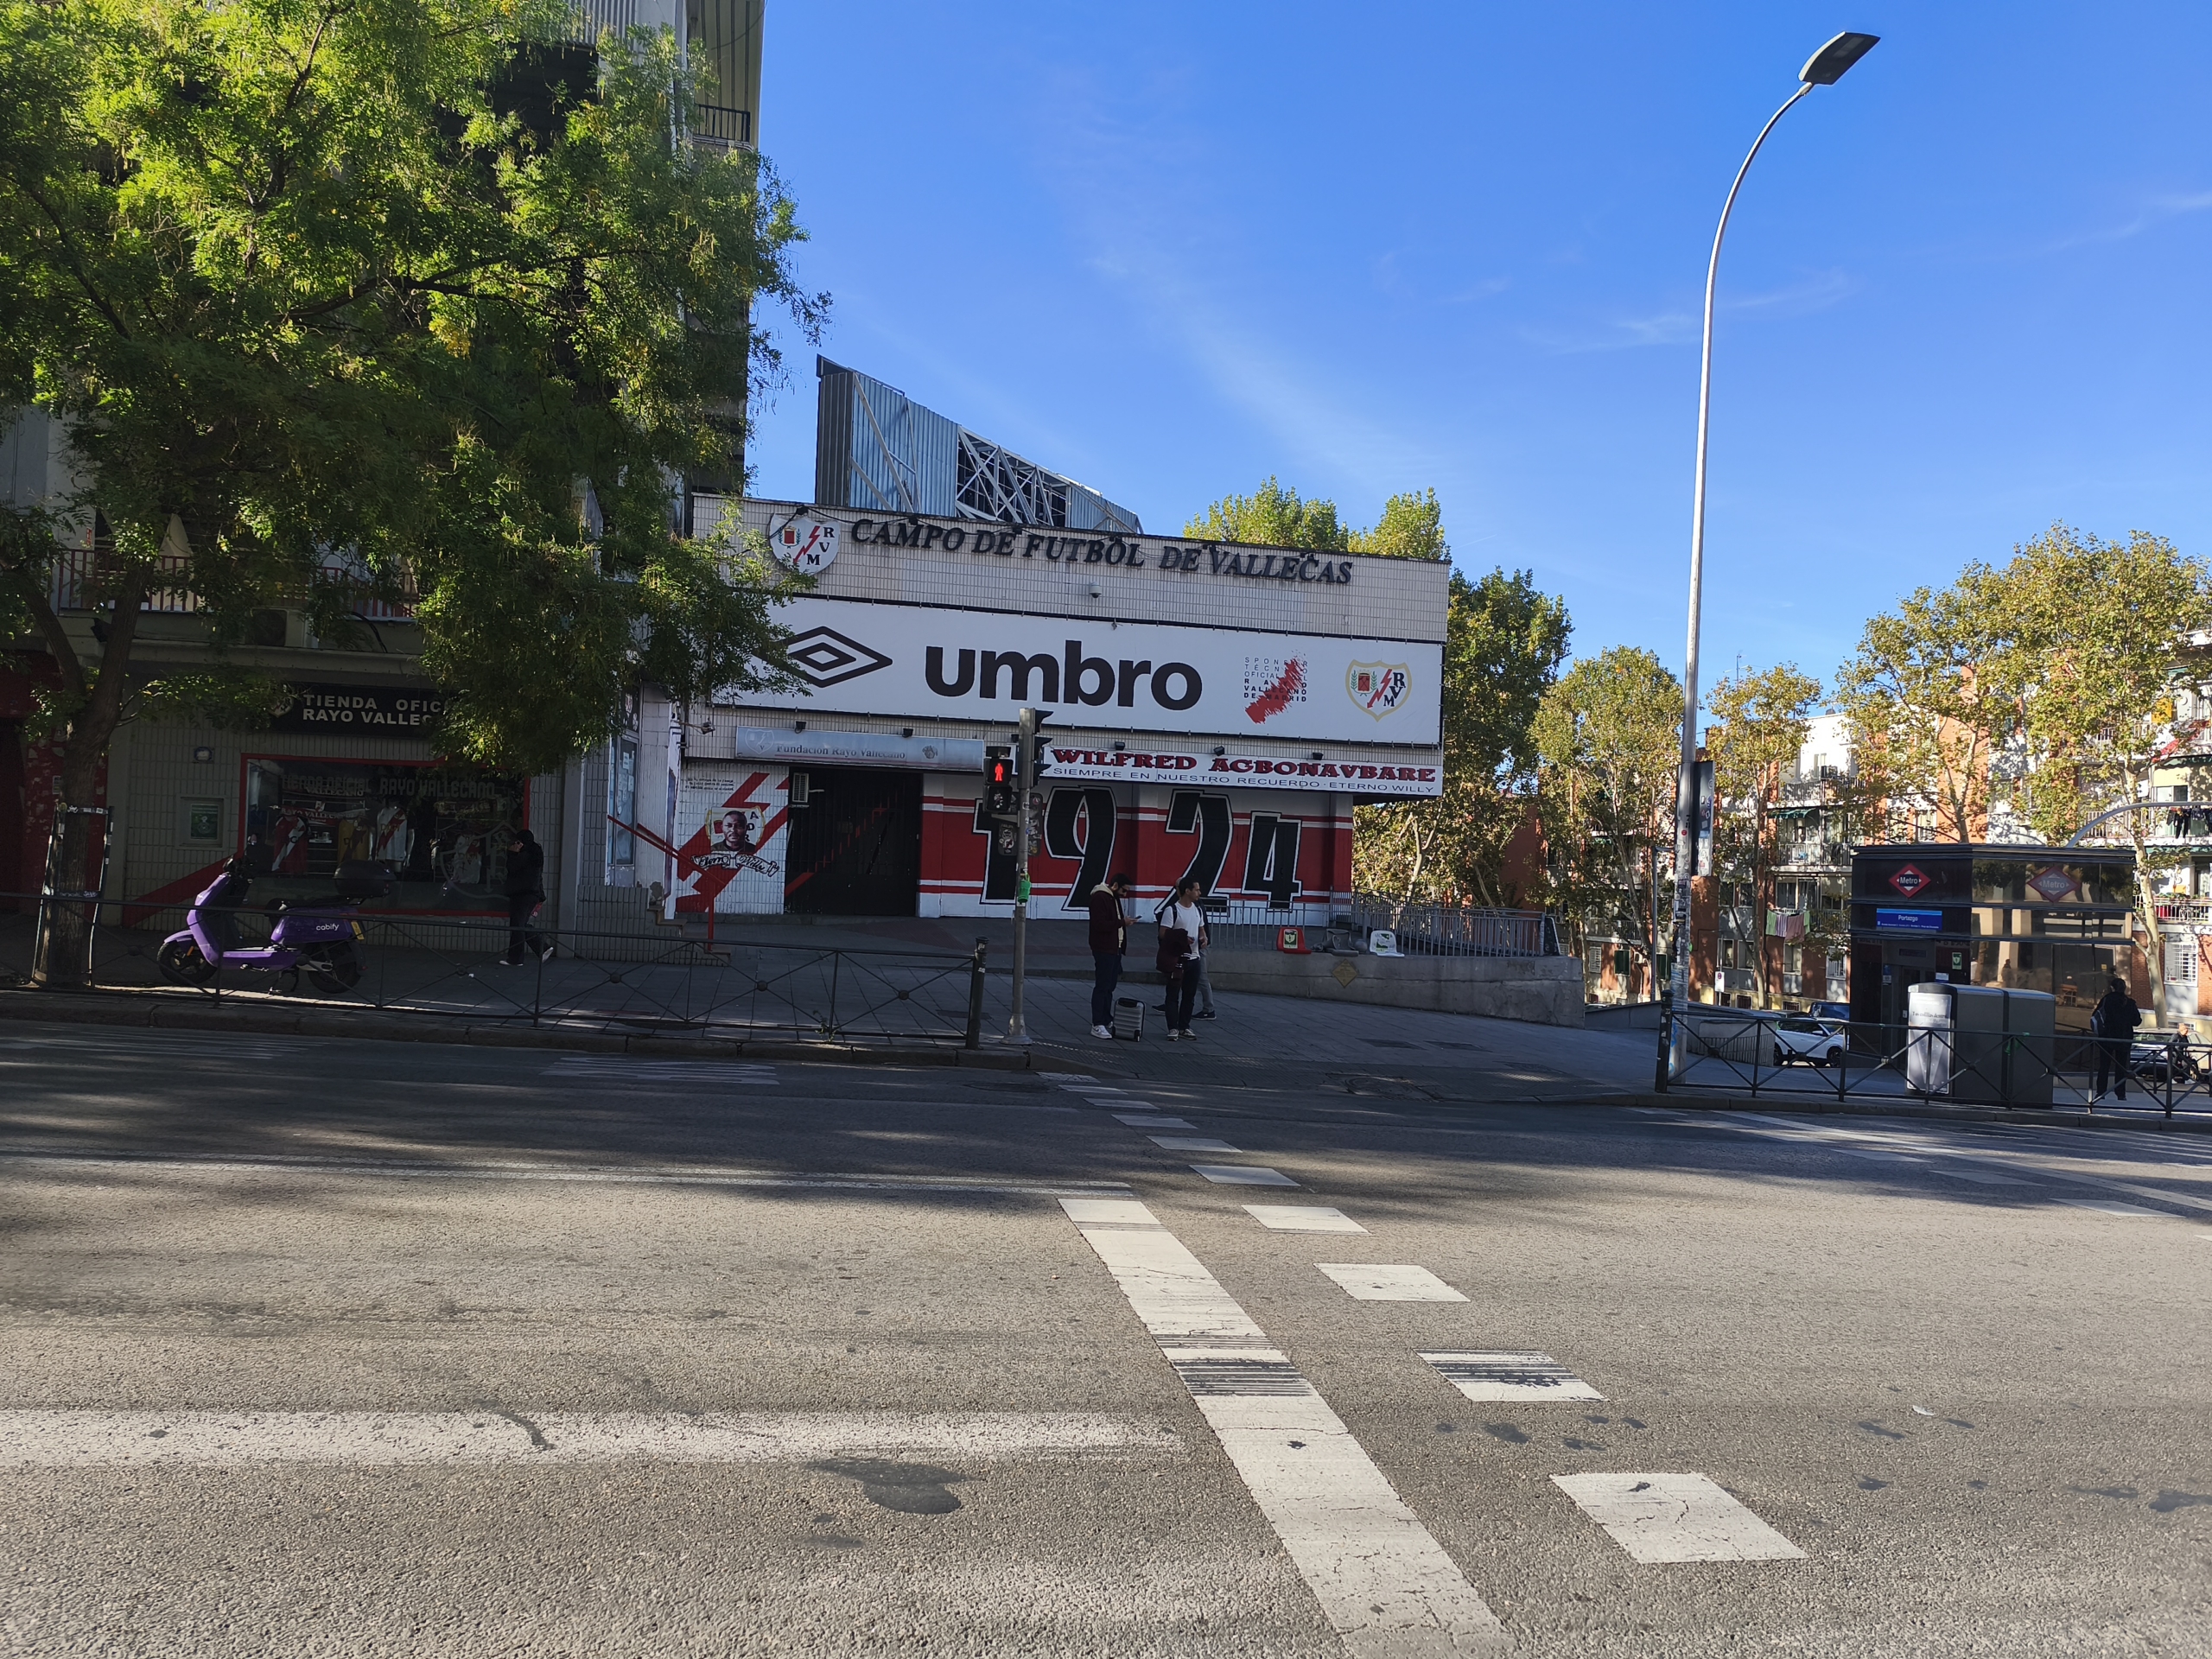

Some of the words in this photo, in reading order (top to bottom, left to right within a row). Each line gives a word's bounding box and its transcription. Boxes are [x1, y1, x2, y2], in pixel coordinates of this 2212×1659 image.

[851, 518, 965, 551] CAMPO
[972, 529, 1017, 556] DE
[1160, 546, 1202, 571] DE
[1210, 550, 1352, 584] VALLECAS
[925, 639, 1203, 711] umbro
[303, 695, 377, 709] TIENDA
[396, 699, 442, 712] OFIC
[303, 709, 353, 722] RAYO
[361, 712, 432, 726] VALLEC
[1051, 749, 1197, 770] WILFRED
[1209, 757, 1436, 783] AGBONAVBARE
[379, 778, 416, 797] RAYO
[1053, 767, 1122, 778] SIEMPRE
[1158, 773, 1230, 784] NUESTRO
[1237, 778, 1319, 788] RECUERDO
[1329, 782, 1387, 791] ETERNO
[1392, 785, 1434, 793] WILLY
[2042, 880, 2065, 888] Metro
[316, 923, 340, 931] cabify
